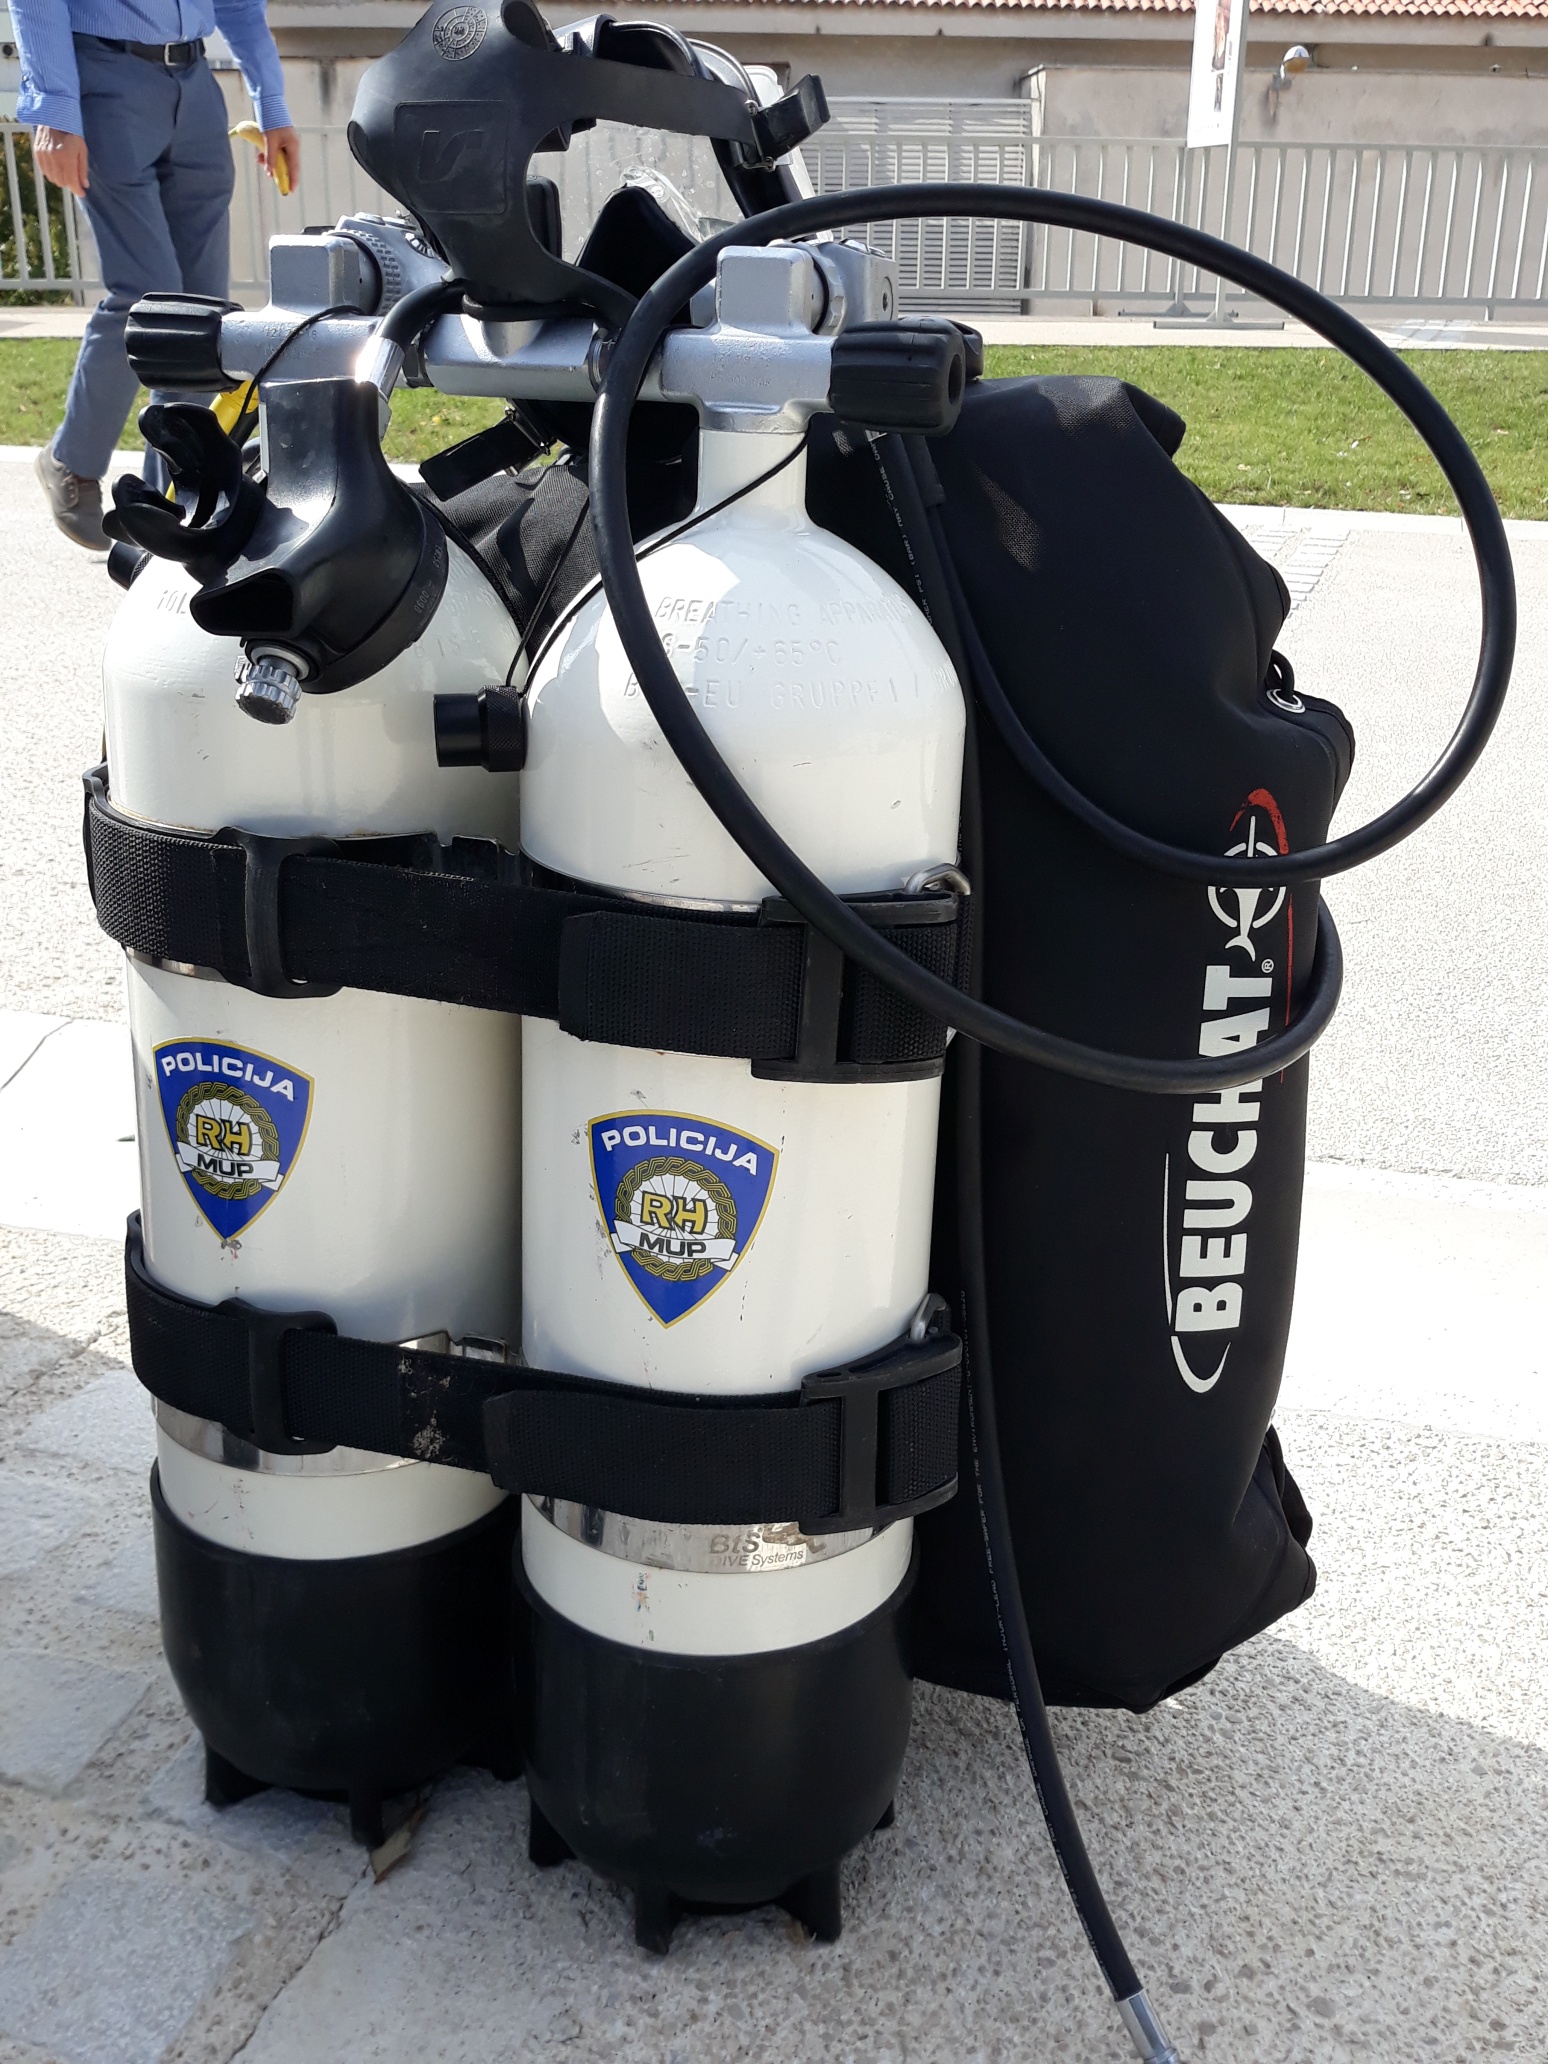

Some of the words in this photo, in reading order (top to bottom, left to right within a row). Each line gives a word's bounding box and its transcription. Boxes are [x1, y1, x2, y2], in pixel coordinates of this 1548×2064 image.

[879, 466, 895, 501] CAUSE
[893, 507, 903, 528] MAY
[654, 595, 801, 627] BREATHING
[161, 1052, 295, 1102] POLICIJA
[196, 1114, 253, 1156] RH
[601, 1125, 758, 1176] POLICIJA
[1175, 964, 1274, 1333] BEUCHAT
[197, 1153, 255, 1177] MUP
[640, 1190, 709, 1235] RH
[638, 1231, 707, 1258] MUP
[751, 1550, 804, 1568] Systems
